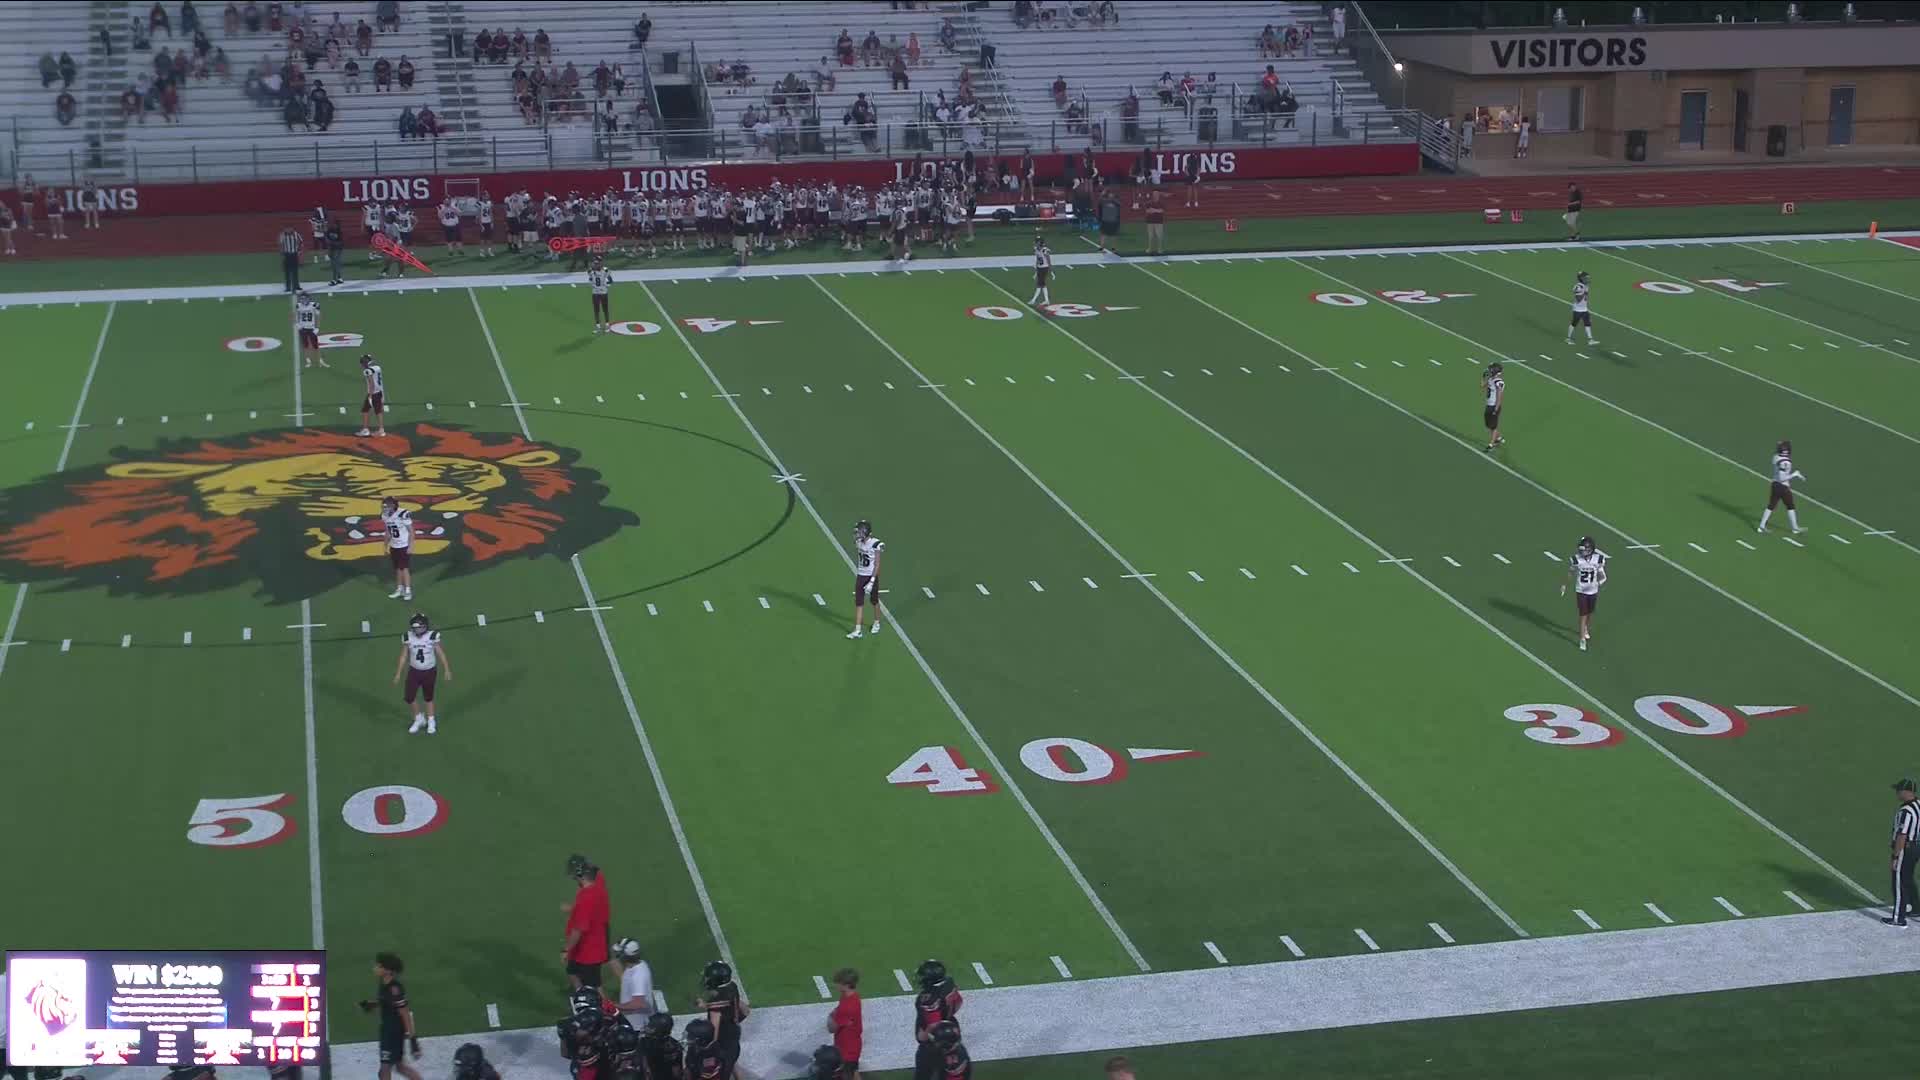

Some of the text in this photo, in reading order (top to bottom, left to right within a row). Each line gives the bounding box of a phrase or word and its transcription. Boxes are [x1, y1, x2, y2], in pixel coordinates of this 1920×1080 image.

[1490, 38, 1647, 68] VISITORS
[342, 178, 430, 202] LIONS
[623, 168, 707, 192] LIONS
[1580, 570, 1595, 583] 21
[415, 648, 425, 663] 4
